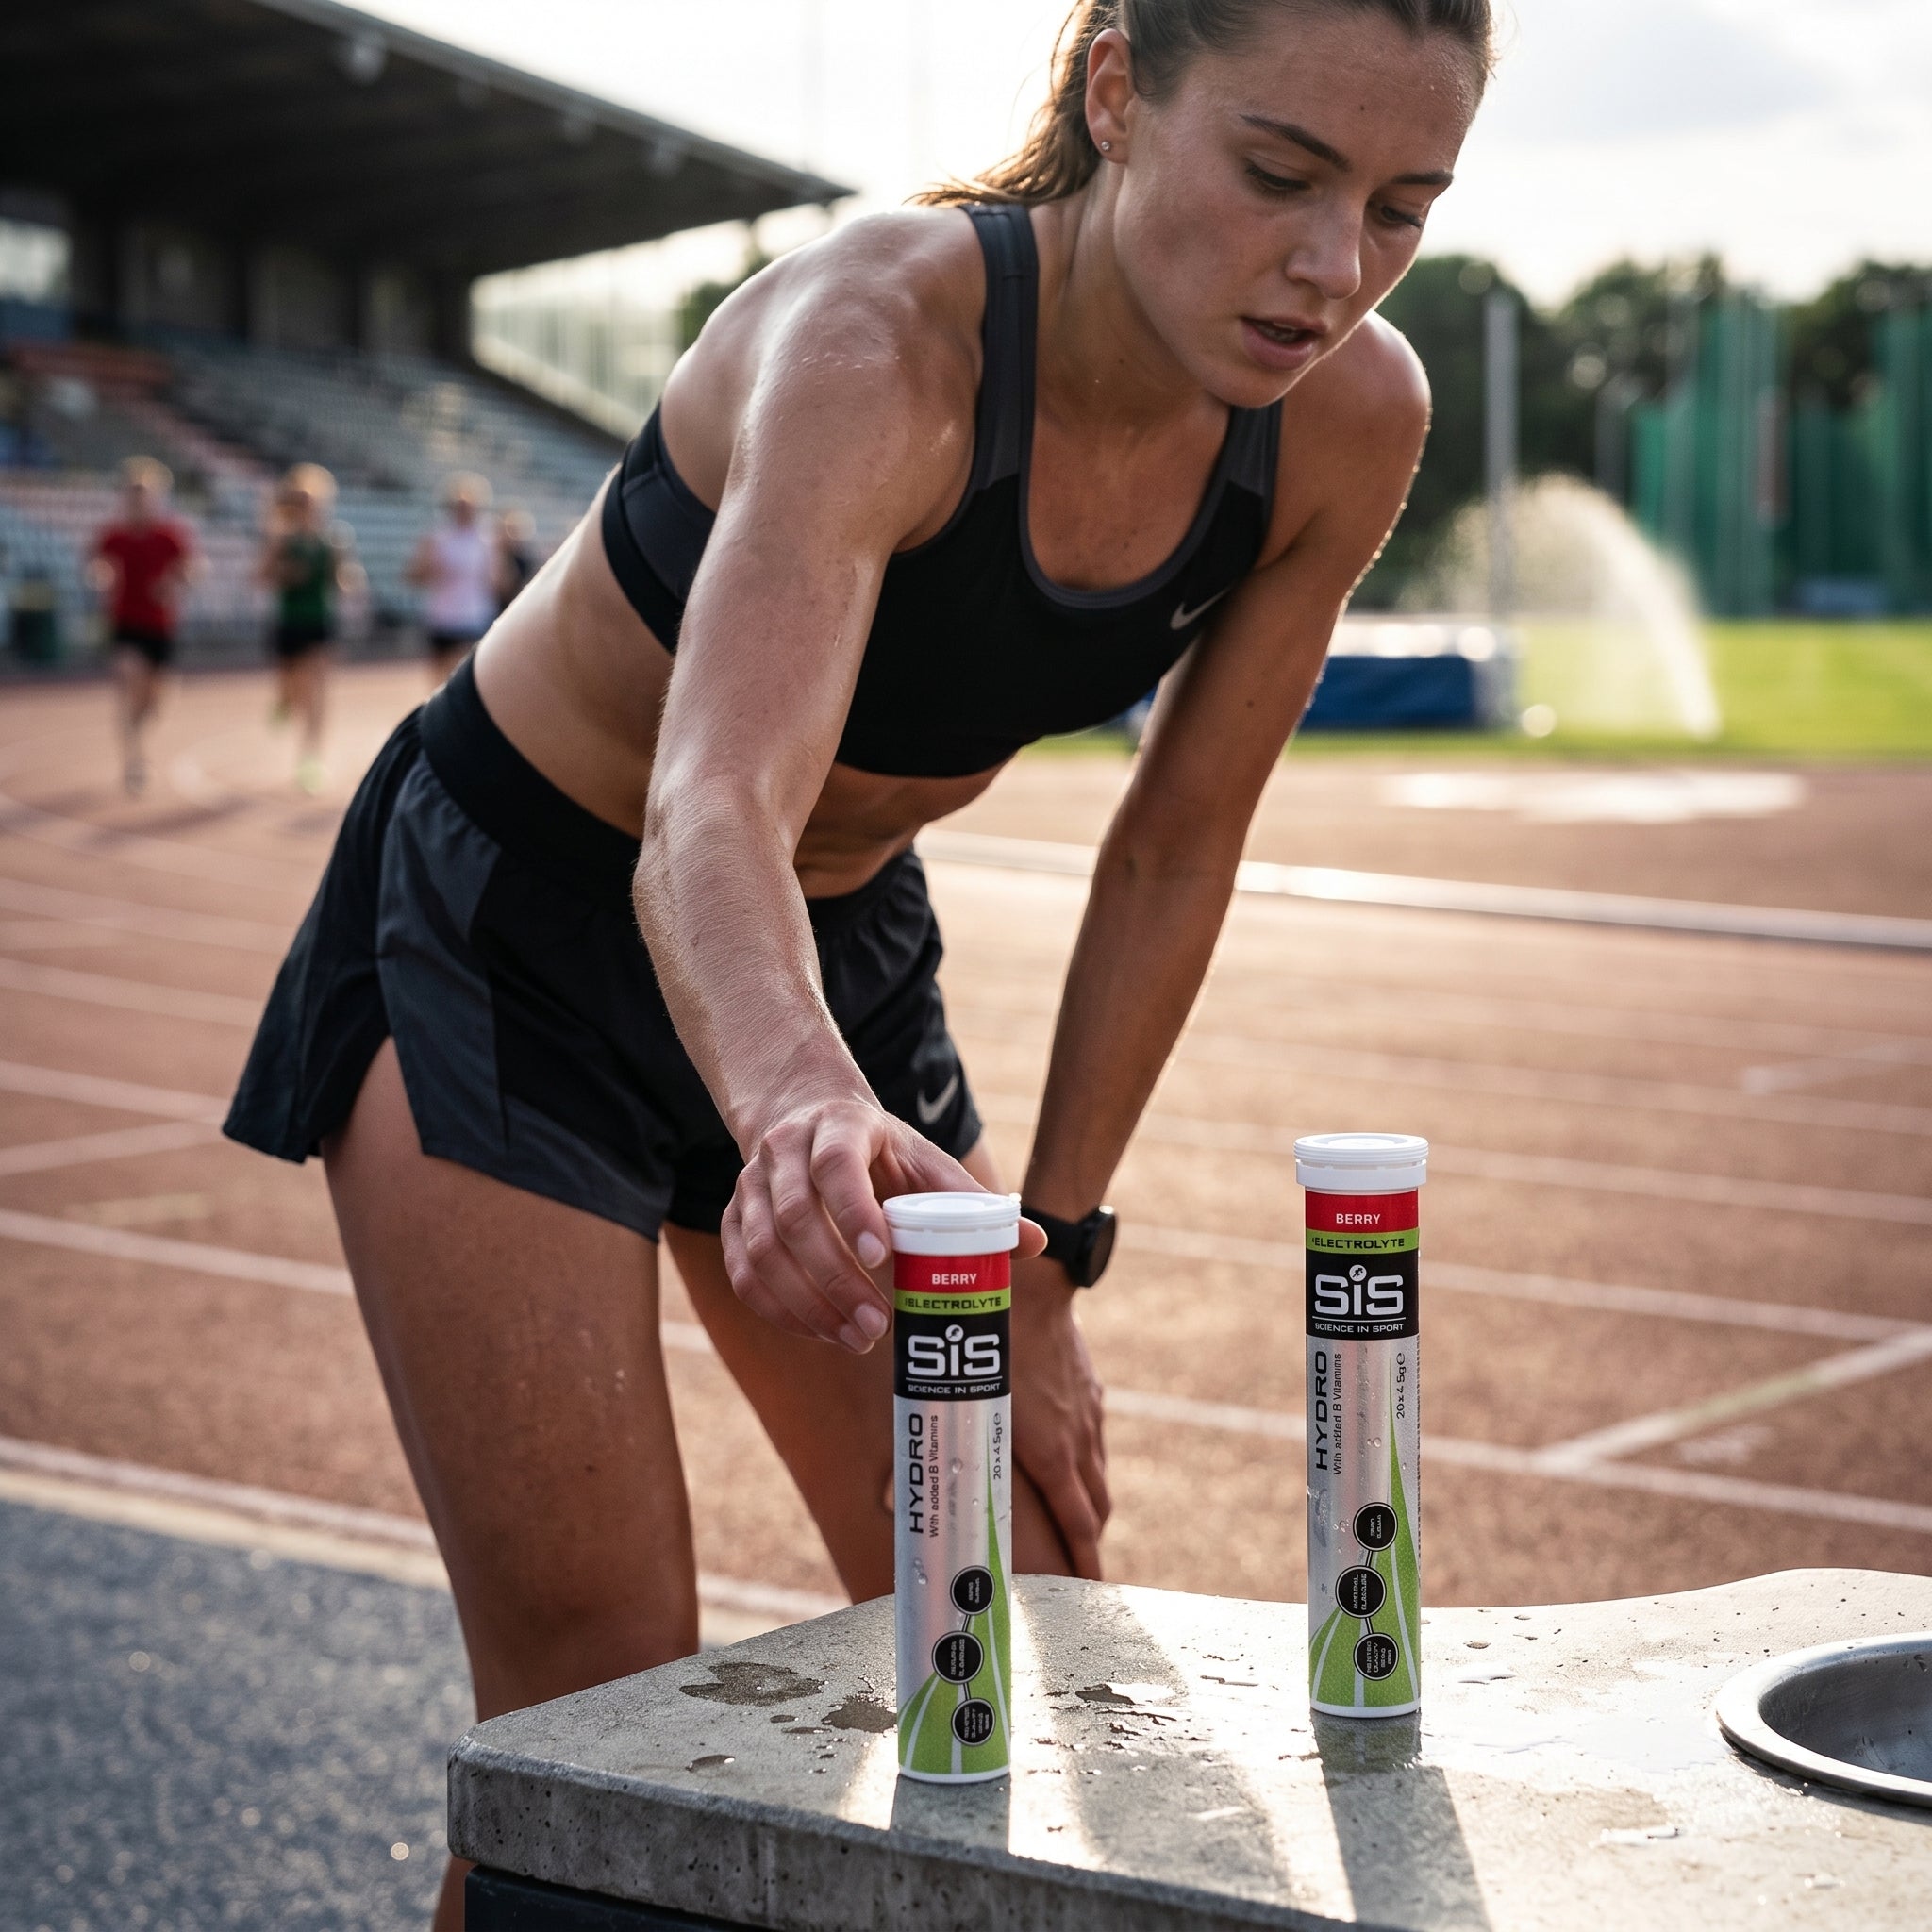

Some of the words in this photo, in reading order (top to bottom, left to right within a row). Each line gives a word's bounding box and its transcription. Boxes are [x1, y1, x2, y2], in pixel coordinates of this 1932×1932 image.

[1336, 1213, 1381, 1224] BERRY
[931, 1274, 977, 1285] BERRY
[1315, 1323, 1354, 1333] SCIENCE
[1373, 1324, 1405, 1333] SPORT
[908, 1384, 951, 1394] SCIENCE
[955, 1386, 967, 1394] IN
[970, 1382, 1001, 1392] SPORT
[1315, 1350, 1328, 1471] HYDRO
[1333, 1403, 1341, 1412] B
[908, 1413, 924, 1534] HYDRO
[929, 1465, 939, 1474] B
